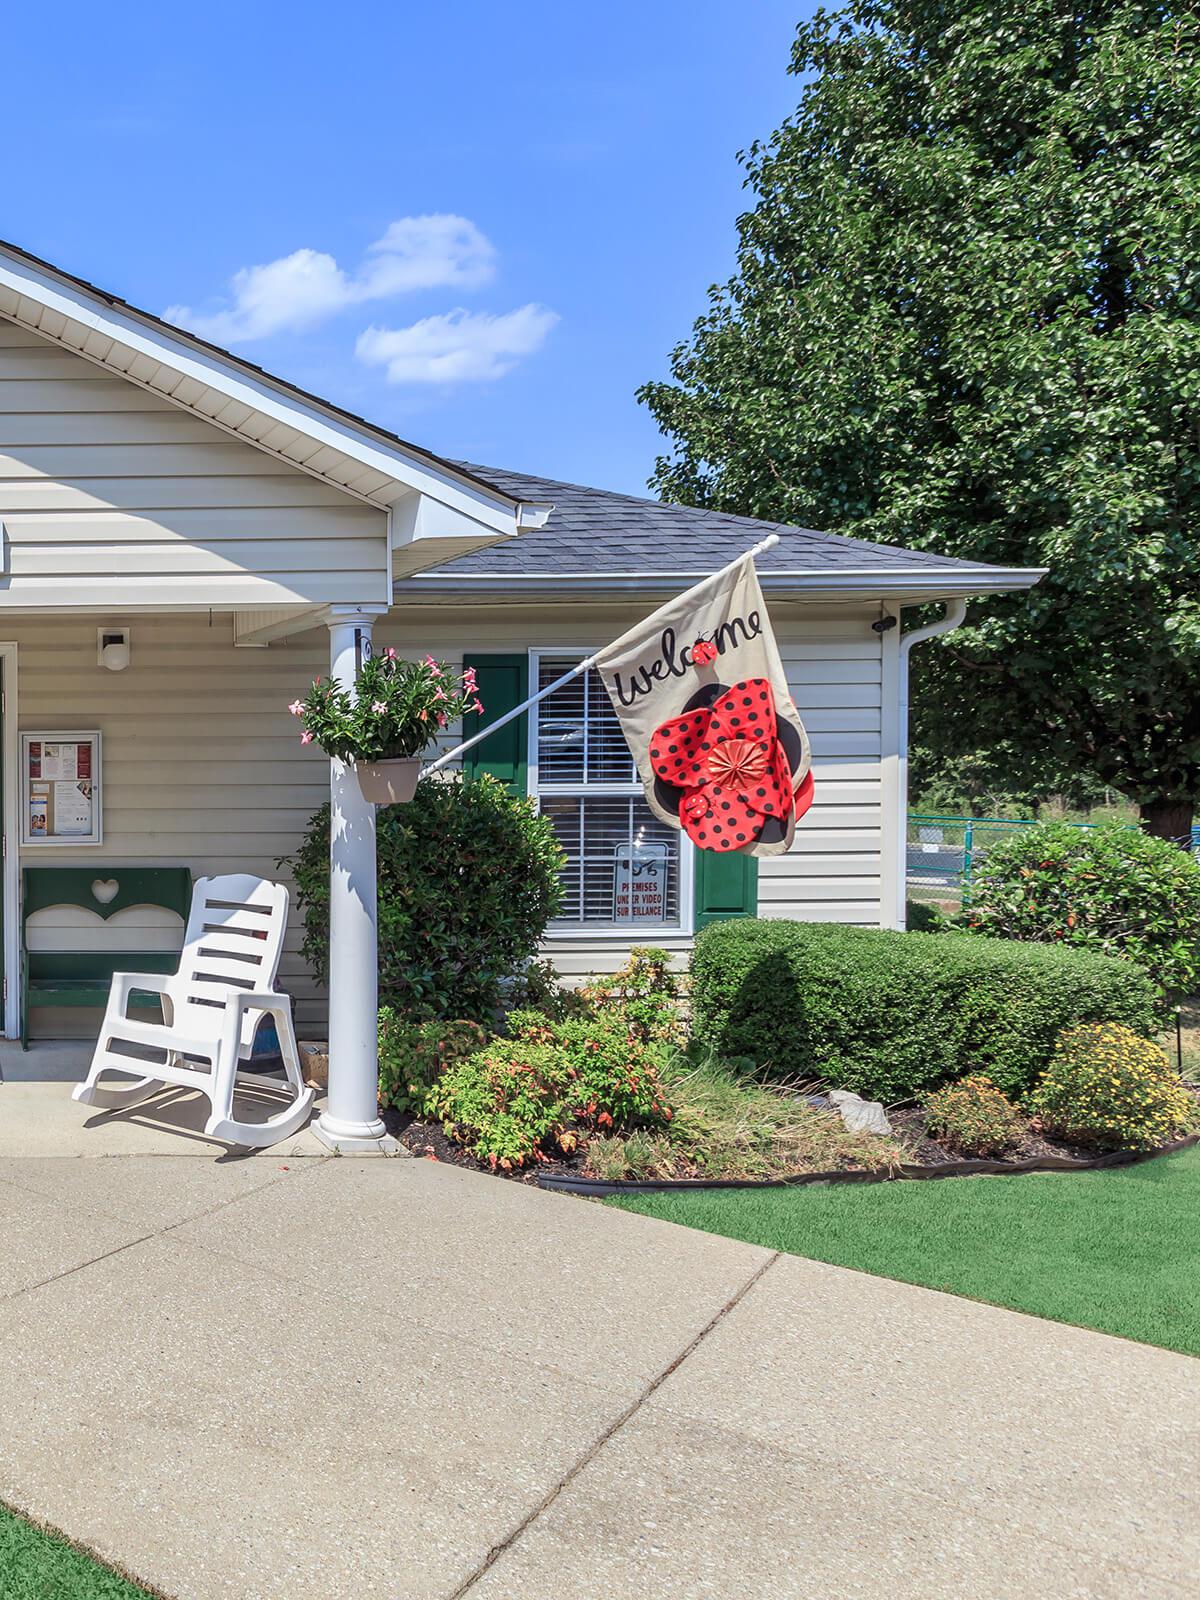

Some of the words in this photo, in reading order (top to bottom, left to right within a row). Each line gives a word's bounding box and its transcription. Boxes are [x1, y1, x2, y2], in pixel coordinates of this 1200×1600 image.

[613, 610, 763, 707] welcme
[642, 894, 662, 904] VIDEO
[616, 906, 662, 916] SUREILLANCE
